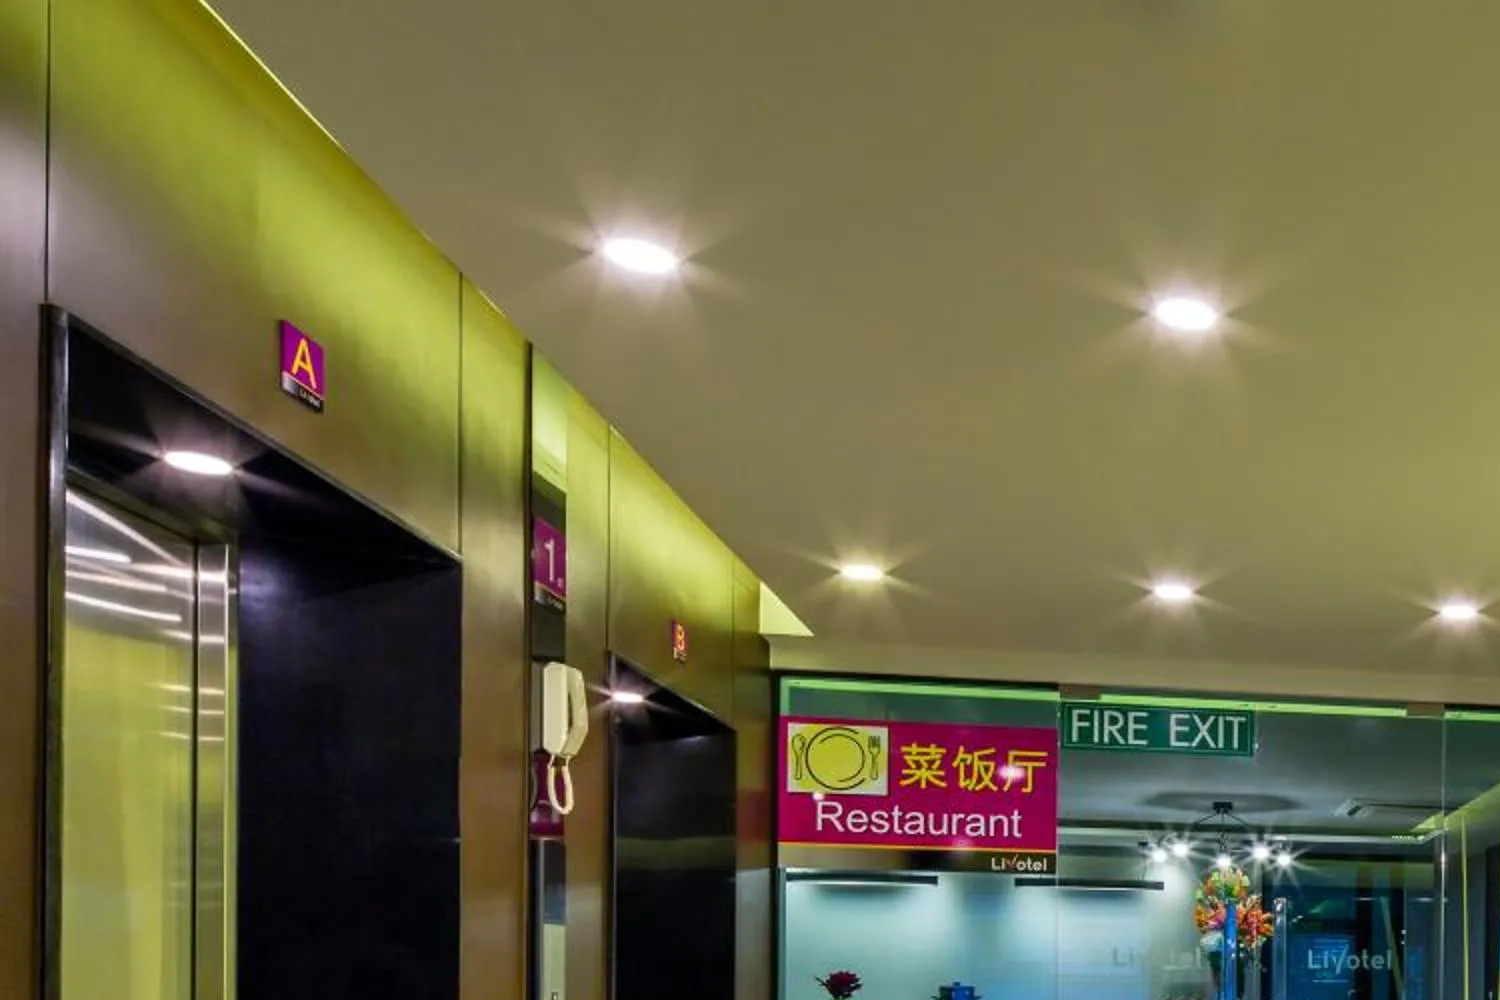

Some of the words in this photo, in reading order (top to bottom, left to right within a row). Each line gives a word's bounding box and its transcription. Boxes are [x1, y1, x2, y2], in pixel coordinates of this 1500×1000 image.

[291, 337, 317, 390] A
[543, 538, 556, 582] 1
[1071, 709, 1149, 745] FIRE
[1169, 713, 1247, 750] EXIT
[899, 743, 1048, 793] 菜饭厅
[815, 800, 1022, 838] Restaurant
